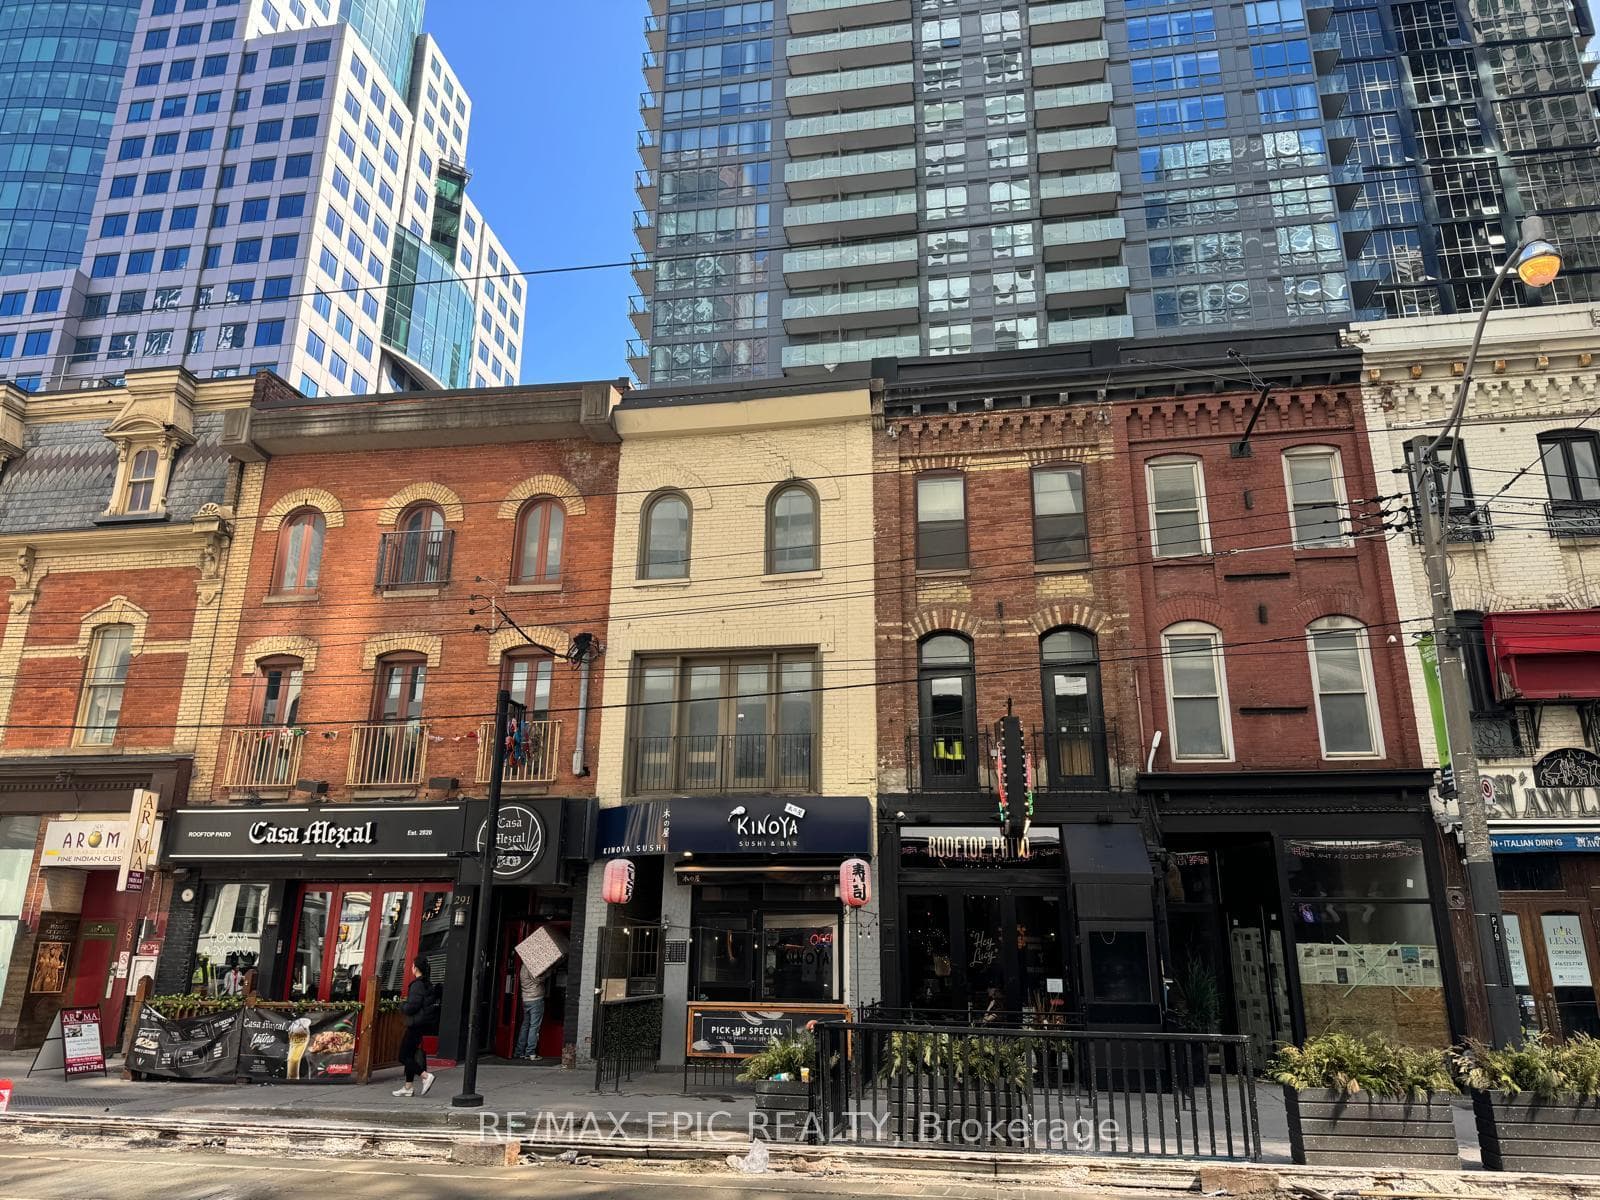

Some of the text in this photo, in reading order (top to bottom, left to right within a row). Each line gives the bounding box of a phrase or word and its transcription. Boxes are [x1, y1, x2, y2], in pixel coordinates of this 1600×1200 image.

[497, 815, 522, 828] Casa
[662, 809, 670, 838] 木の屋
[737, 813, 798, 838] KINOYA
[62, 831, 121, 848] AROM
[249, 820, 373, 848] Casa Mezcal
[1503, 839, 1534, 847] ITALIAN
[1535, 838, 1563, 847] DINING
[603, 844, 667, 854] KINOYA SUSHI
[928, 835, 986, 858] ROOFTOP
[852, 862, 866, 901] 寿司
[454, 895, 471, 905] 291
[973, 930, 996, 950] Hey
[1549, 936, 1581, 945] LEASE
[969, 947, 997, 967] Lucy
[63, 1011, 99, 1022] AROMA
[711, 1026, 783, 1036] PICK-UP SPECIAL
